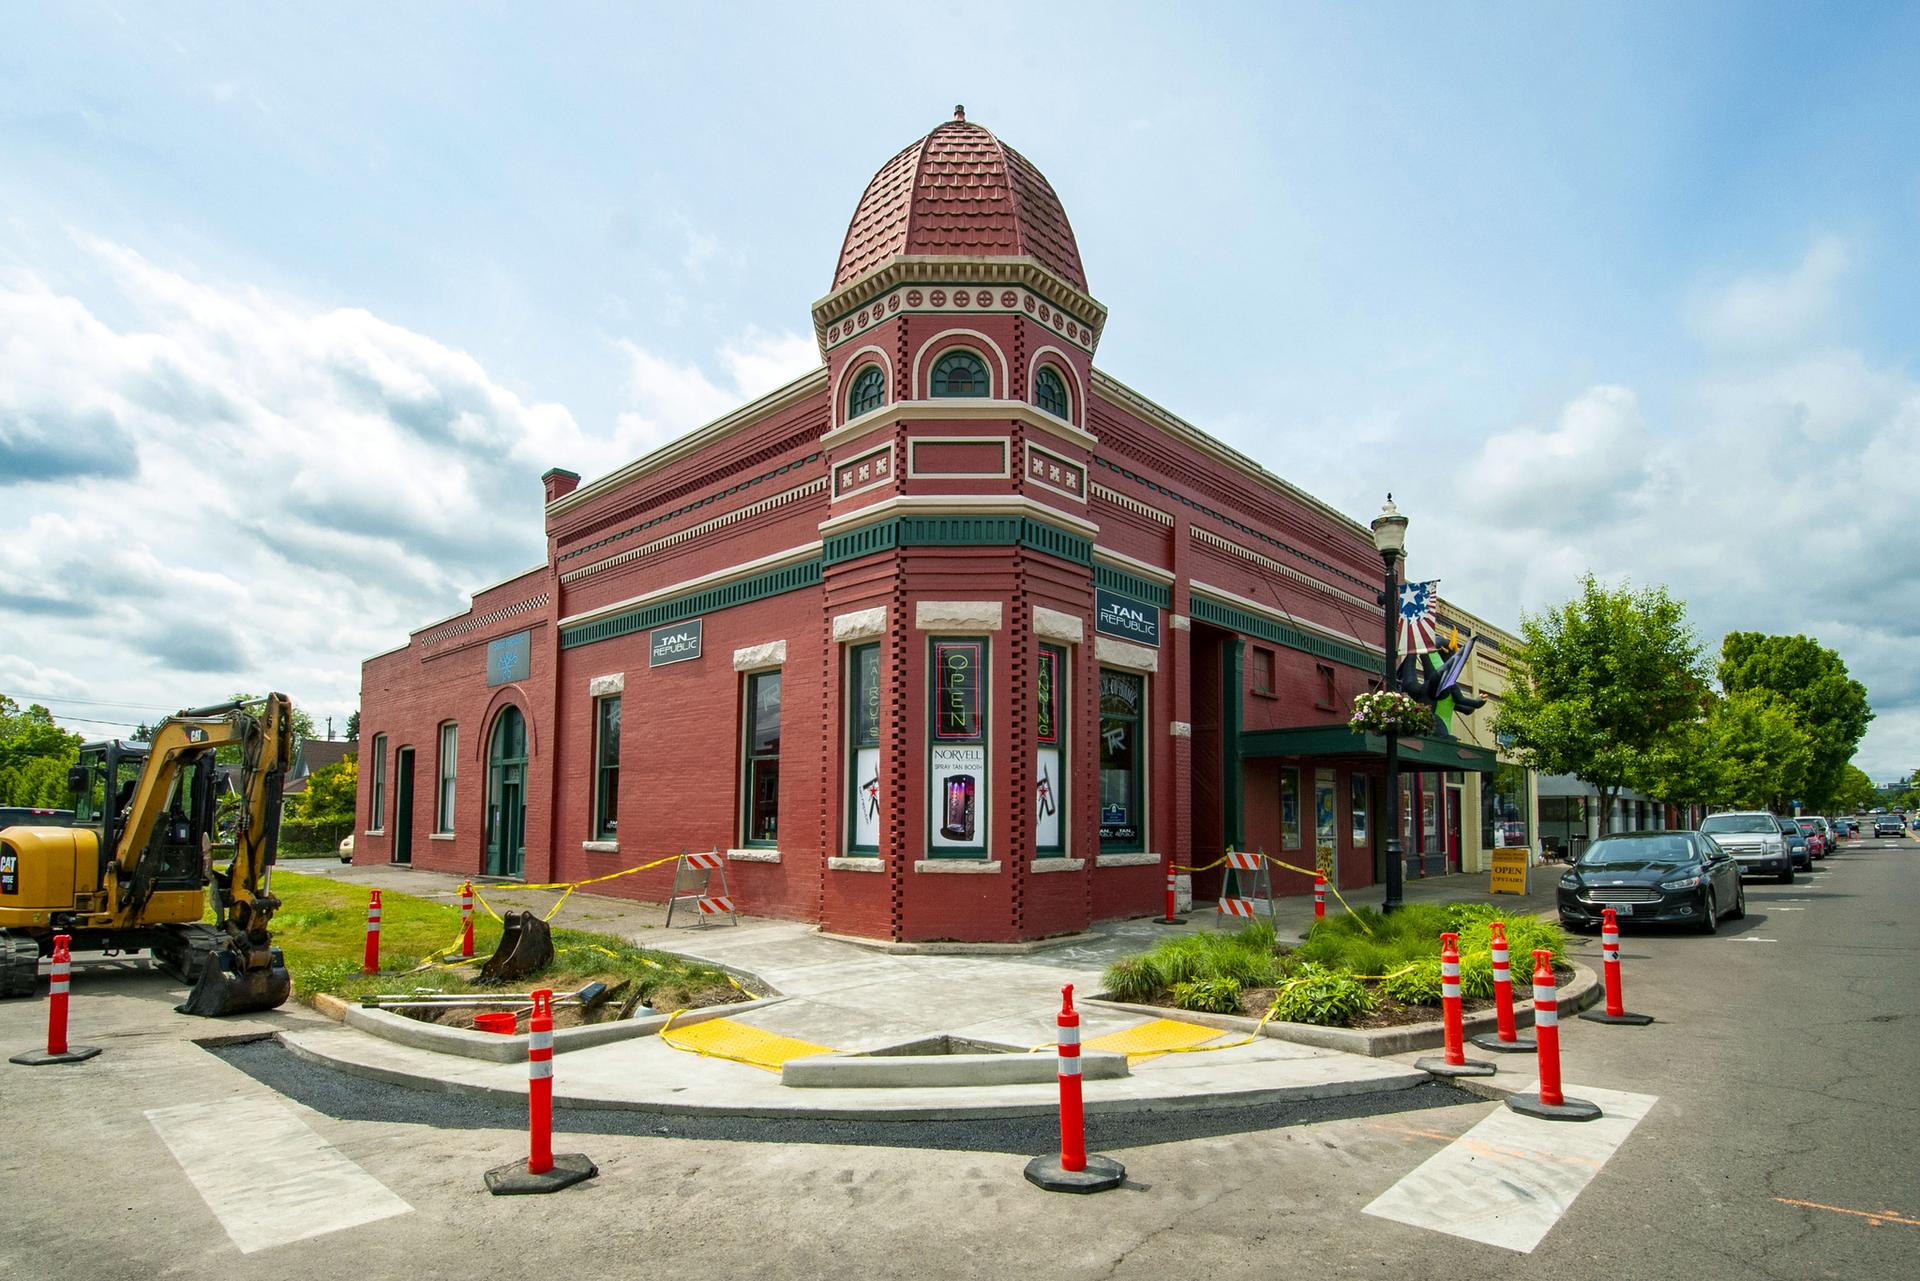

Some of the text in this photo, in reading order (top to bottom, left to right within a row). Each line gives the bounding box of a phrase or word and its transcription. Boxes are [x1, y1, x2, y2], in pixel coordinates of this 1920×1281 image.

[1111, 604, 1143, 622] TAN
[1101, 612, 1155, 635] REPUBLIC
[662, 632, 687, 646] TAN
[653, 640, 697, 657] REPUBLIC
[869, 657, 880, 737] HAIRCUTS
[948, 655, 968, 727] OPEN
[1038, 657, 1049, 735] TANNING
[191, 730, 202, 742] CAT
[935, 750, 982, 761] NORVELL
[0, 856, 17, 873] CAT
[1495, 867, 1522, 875] OPEN
